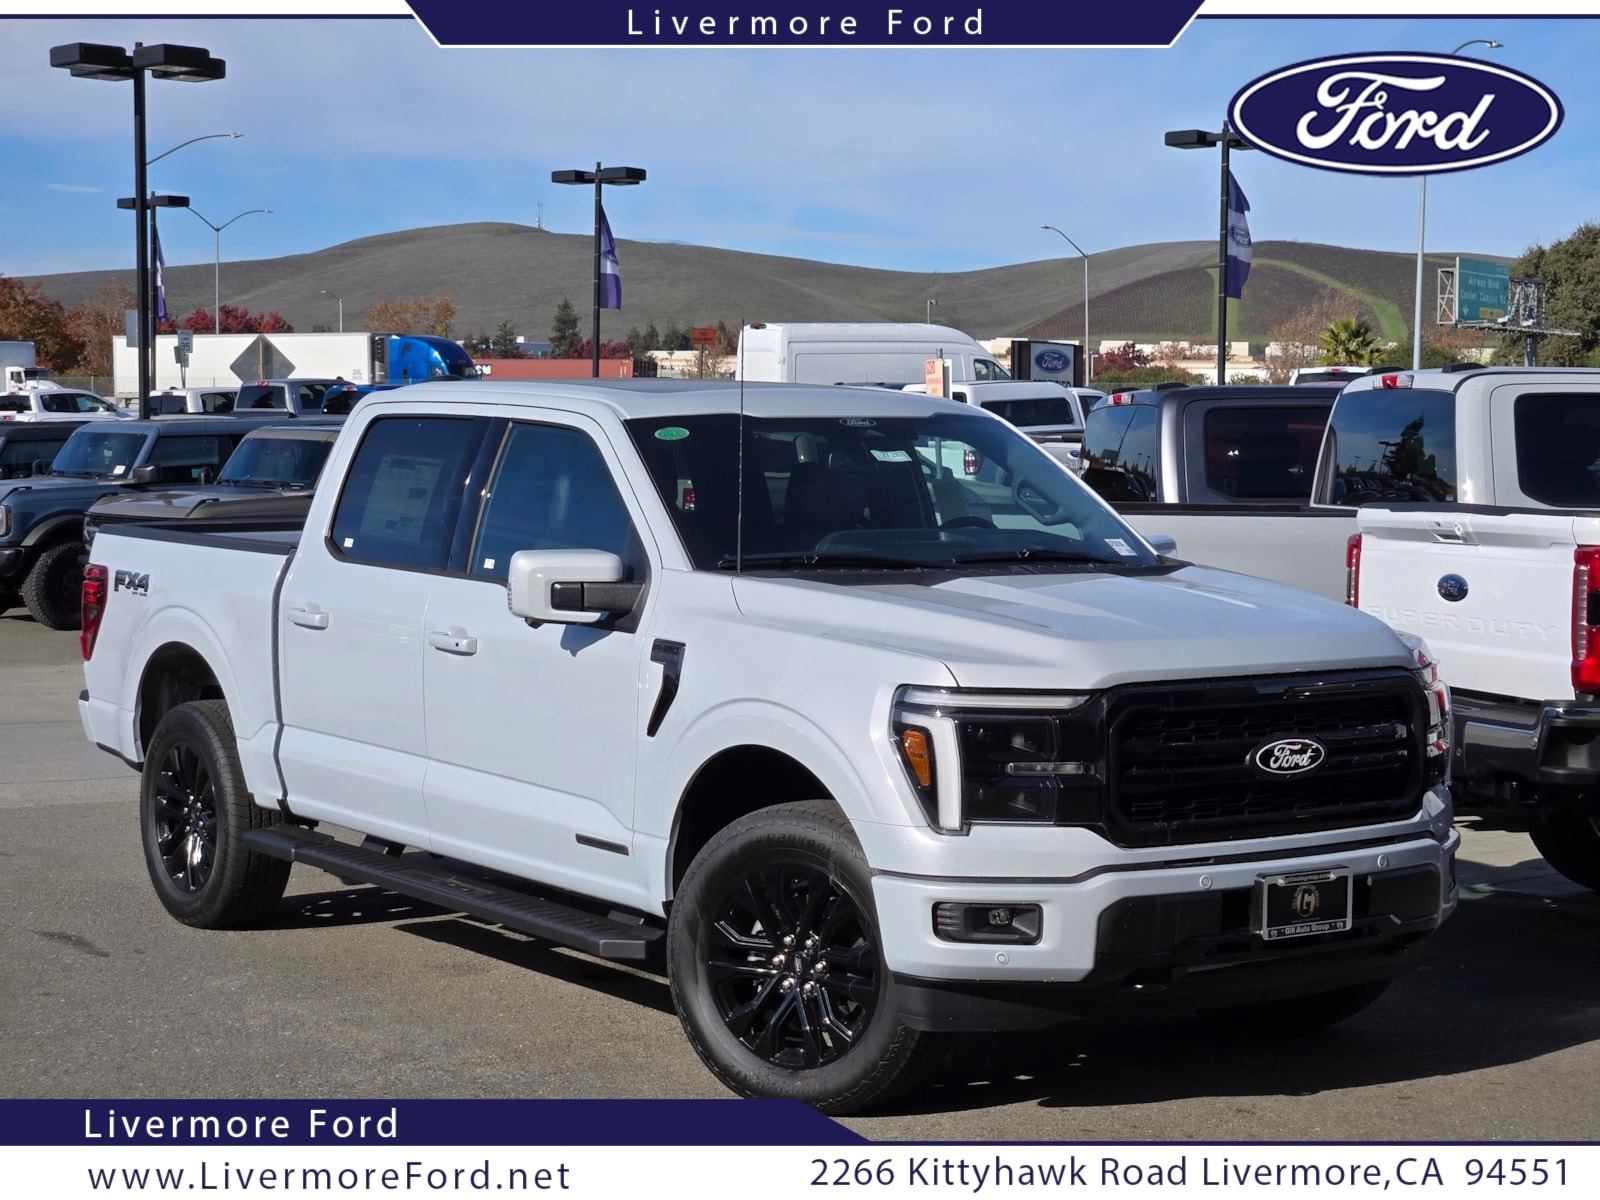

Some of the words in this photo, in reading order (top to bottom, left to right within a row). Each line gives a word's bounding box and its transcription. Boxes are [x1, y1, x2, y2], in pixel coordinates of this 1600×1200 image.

[1042, 352, 1064, 369] Ford
[114, 569, 150, 592] FX4
[1366, 605, 1460, 631] SUPER
[1463, 615, 1557, 641] DUTY
[1269, 744, 1314, 769] Ford
[1285, 926, 1296, 935] Gill
[1296, 924, 1311, 933] Auto
[1311, 923, 1330, 932] Group
